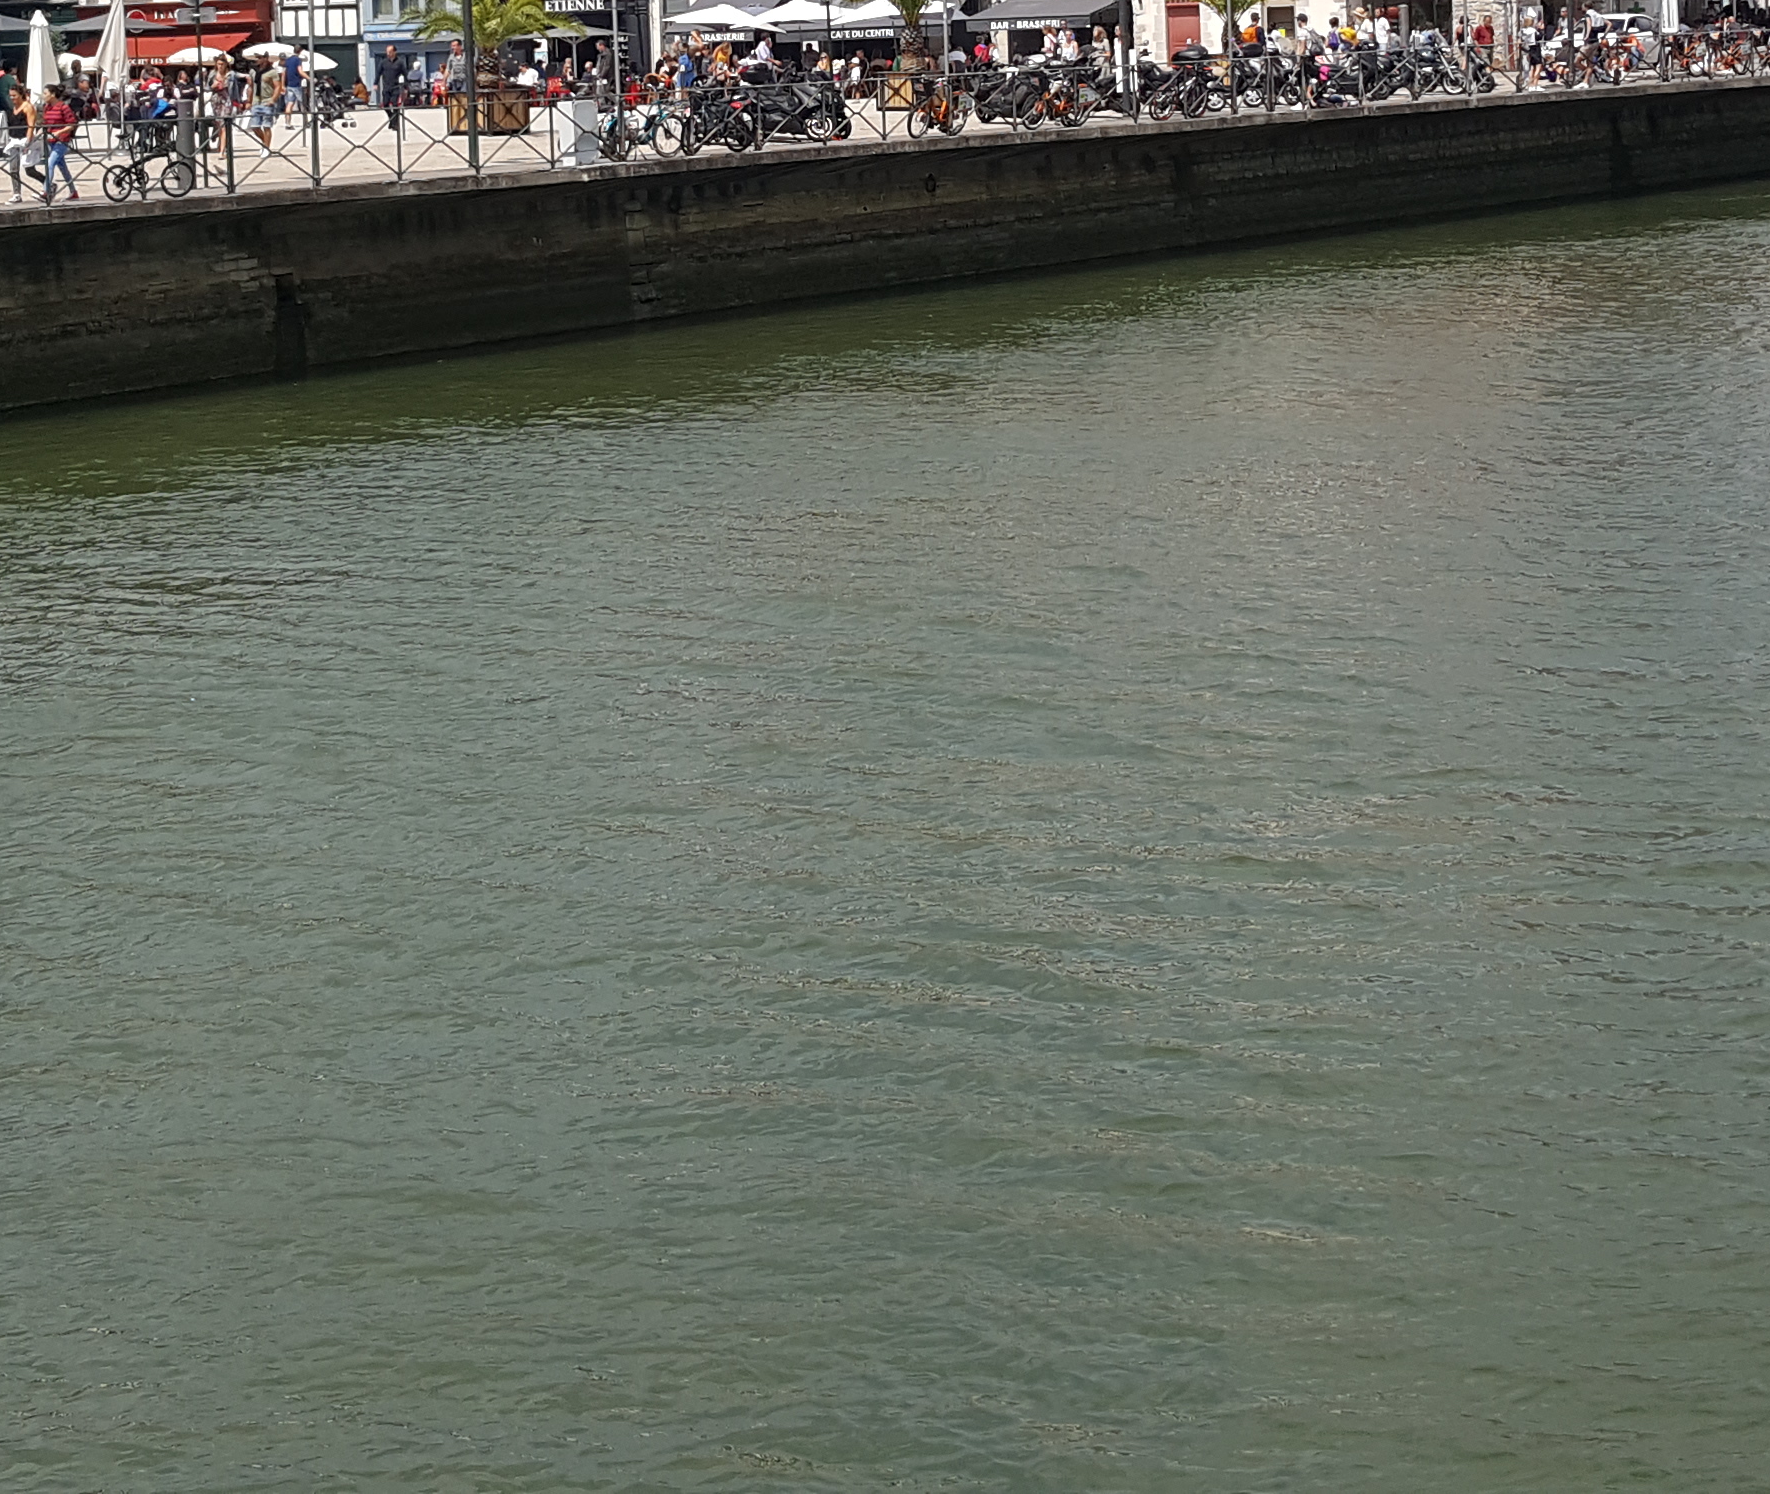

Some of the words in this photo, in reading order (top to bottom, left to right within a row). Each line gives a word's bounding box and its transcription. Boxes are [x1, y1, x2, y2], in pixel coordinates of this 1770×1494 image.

[990, 21, 1009, 30] BAR
[1016, 19, 1060, 29] BRASSERI
[851, 29, 864, 38] DU
